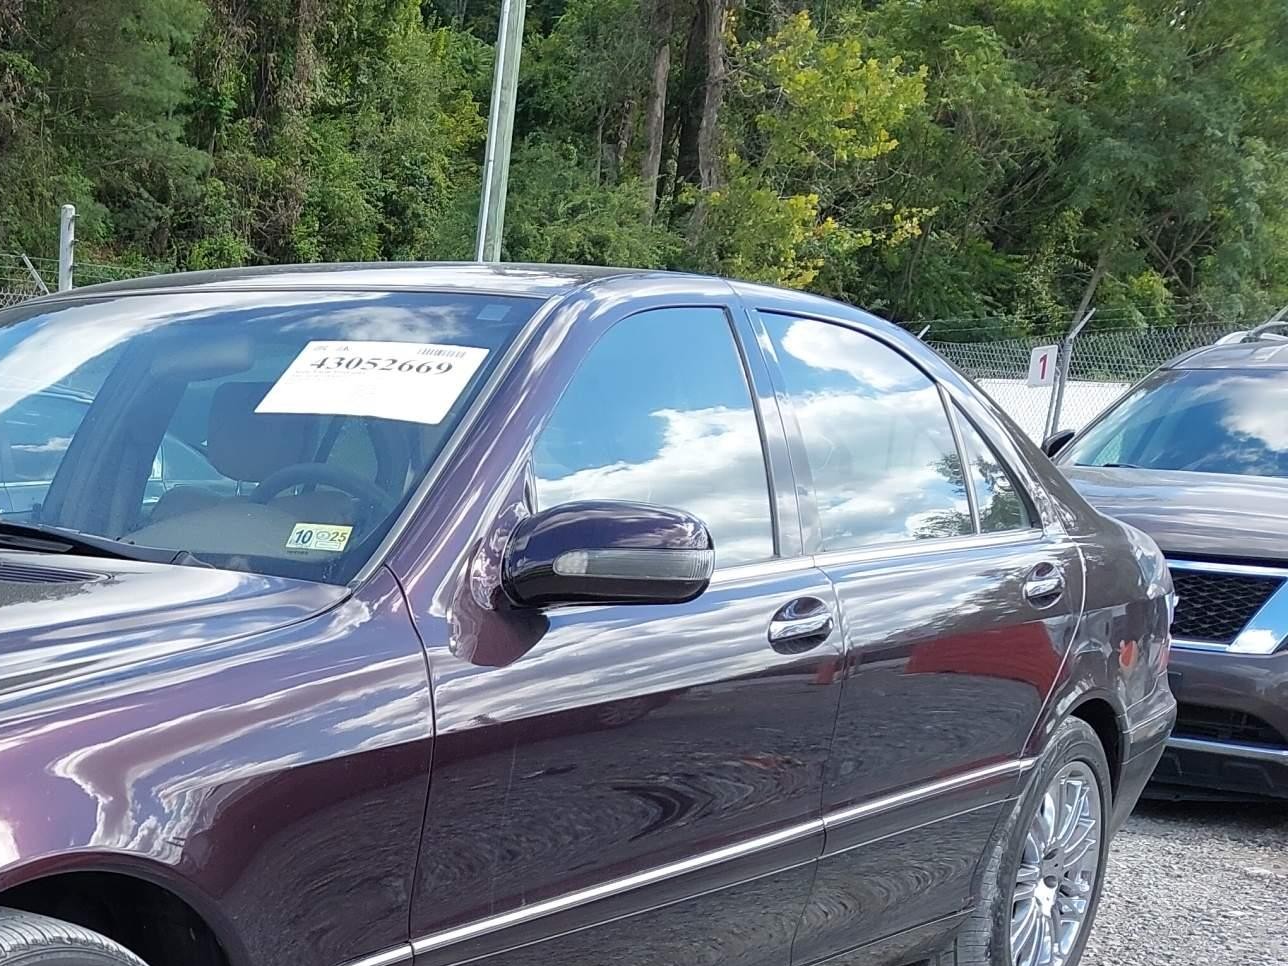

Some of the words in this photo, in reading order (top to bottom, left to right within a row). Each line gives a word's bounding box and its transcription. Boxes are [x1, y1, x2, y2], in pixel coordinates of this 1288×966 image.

[310, 356, 453, 376] 43052669
[1039, 353, 1048, 379] 1
[295, 529, 313, 543] 10
[329, 531, 347, 543] 25
